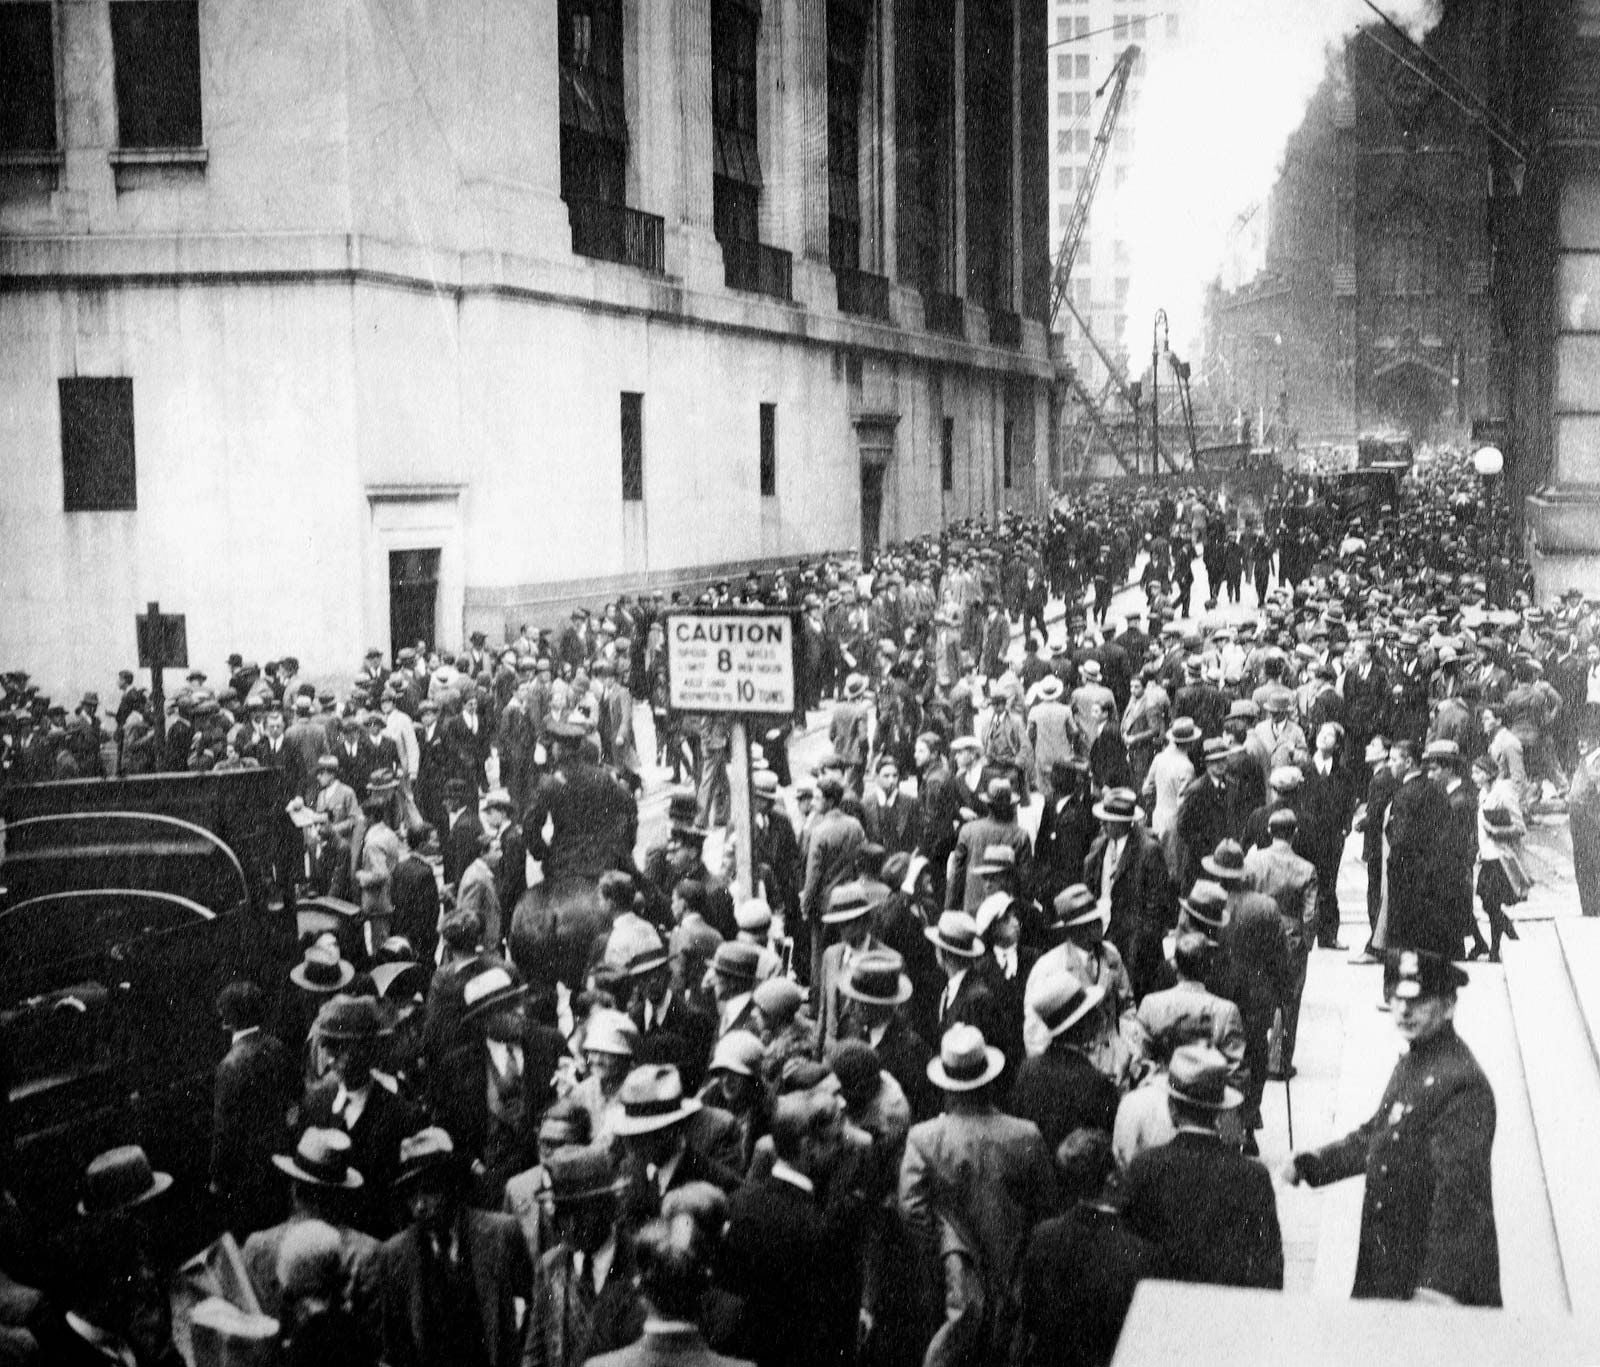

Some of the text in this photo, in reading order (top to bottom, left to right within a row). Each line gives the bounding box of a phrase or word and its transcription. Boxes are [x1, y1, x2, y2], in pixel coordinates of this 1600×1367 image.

[676, 623, 782, 643] CAUTION
[718, 648, 732, 673] 8
[737, 679, 755, 702] 10
